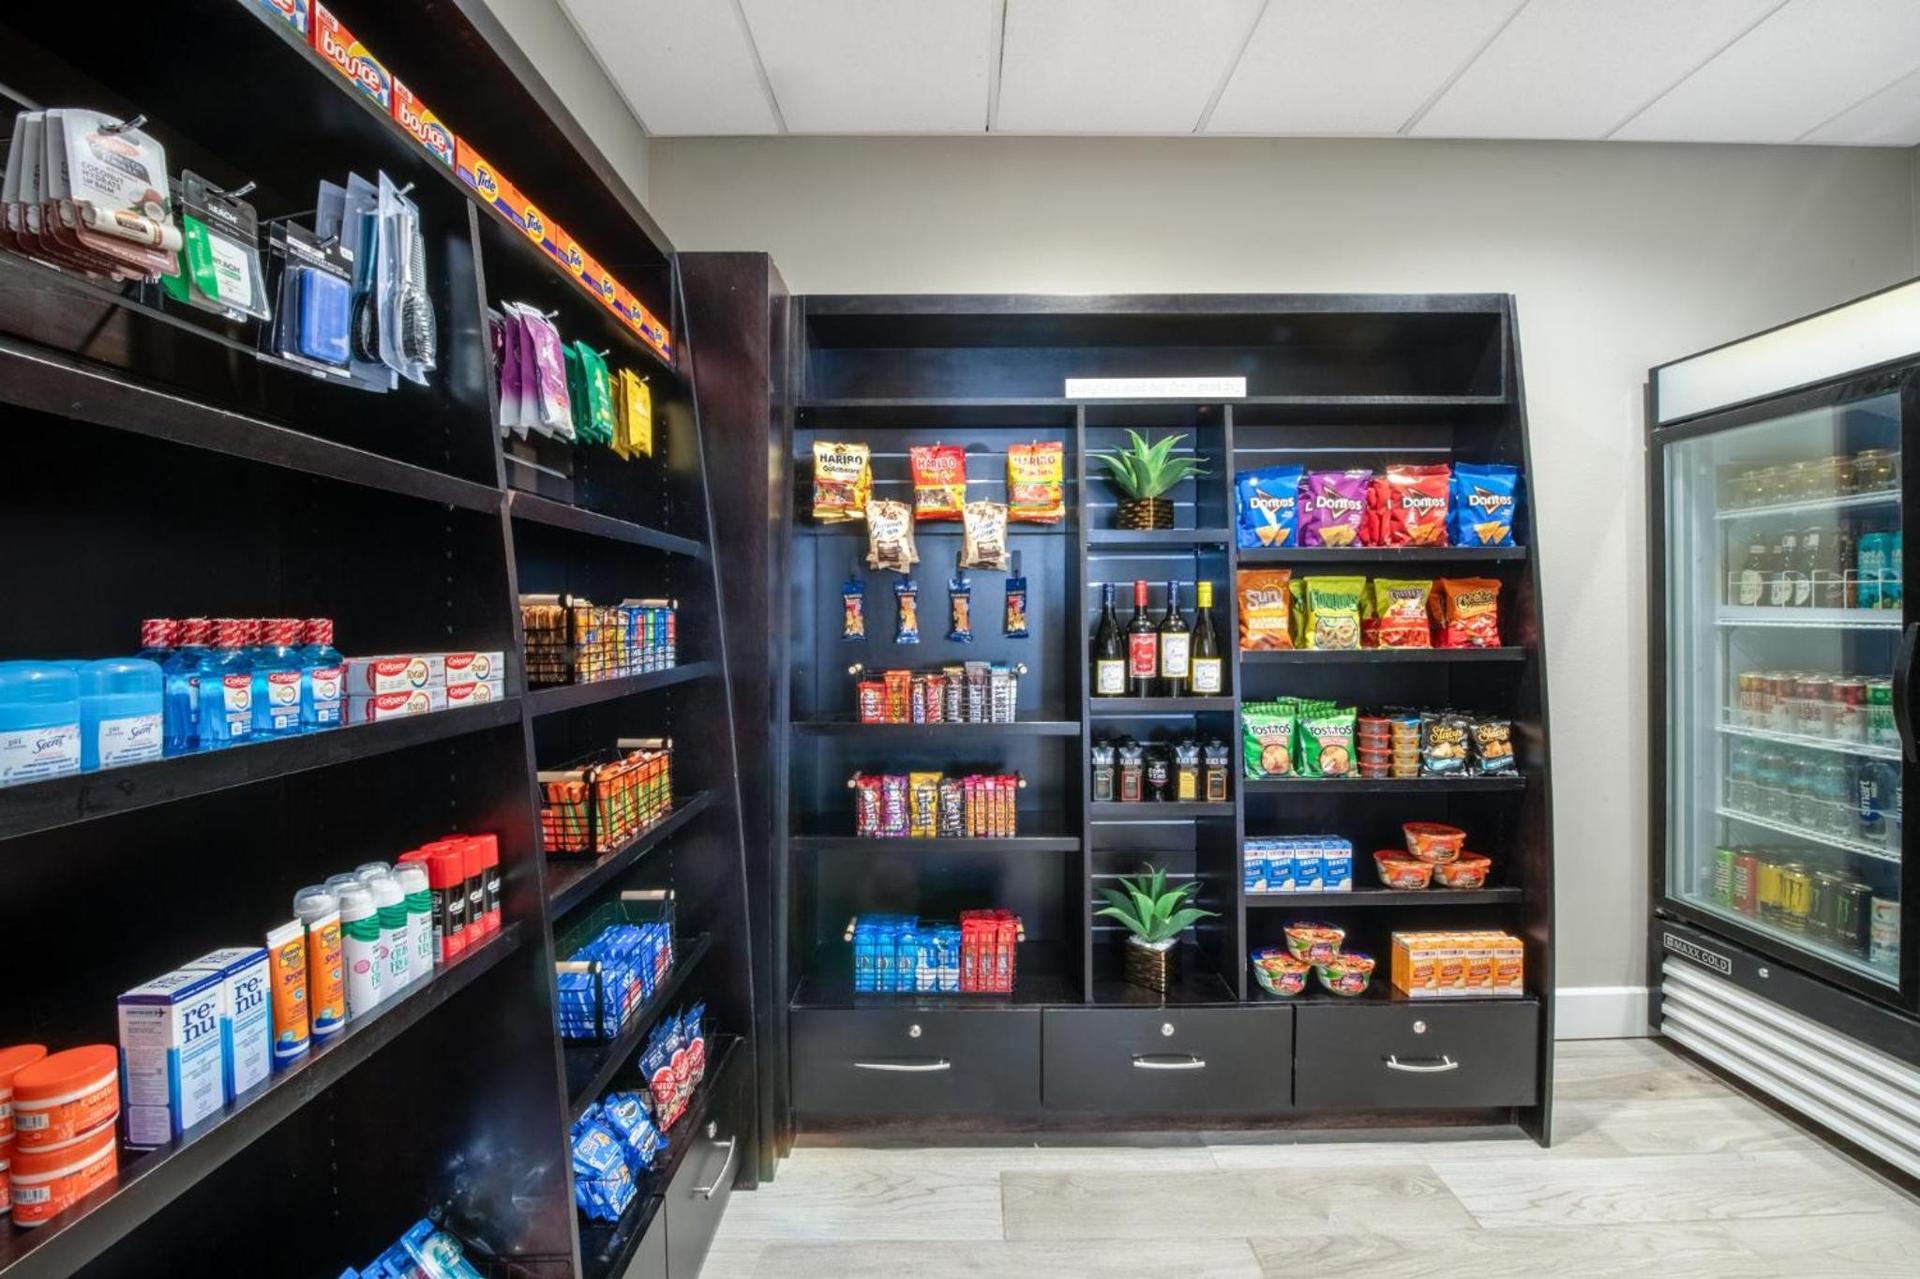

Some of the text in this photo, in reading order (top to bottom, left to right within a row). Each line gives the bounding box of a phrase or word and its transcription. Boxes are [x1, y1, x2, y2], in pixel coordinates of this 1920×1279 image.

[322, 29, 381, 89] bounce
[400, 103, 446, 150] bounce
[477, 168, 497, 193] Tide
[527, 212, 543, 234] Tide
[570, 248, 583, 267] Tide
[602, 280, 614, 295] Tide
[1250, 497, 1294, 508] Doritos
[1317, 496, 1362, 510] Doritos
[1403, 497, 1445, 508] Doritos
[1469, 495, 1512, 506] Doritos
[378, 662, 407, 672] Colgate
[448, 656, 473, 665] Colgate
[471, 663, 487, 672] Total
[407, 669, 425, 679] Total
[450, 686, 474, 695] Colgate
[378, 696, 408, 706] Colgate
[128, 723, 154, 740] Secret
[32, 734, 66, 754] Secret
[1675, 940, 1728, 970] MAXX COLD
[236, 989, 263, 1016] nu
[183, 1016, 217, 1044] nu
